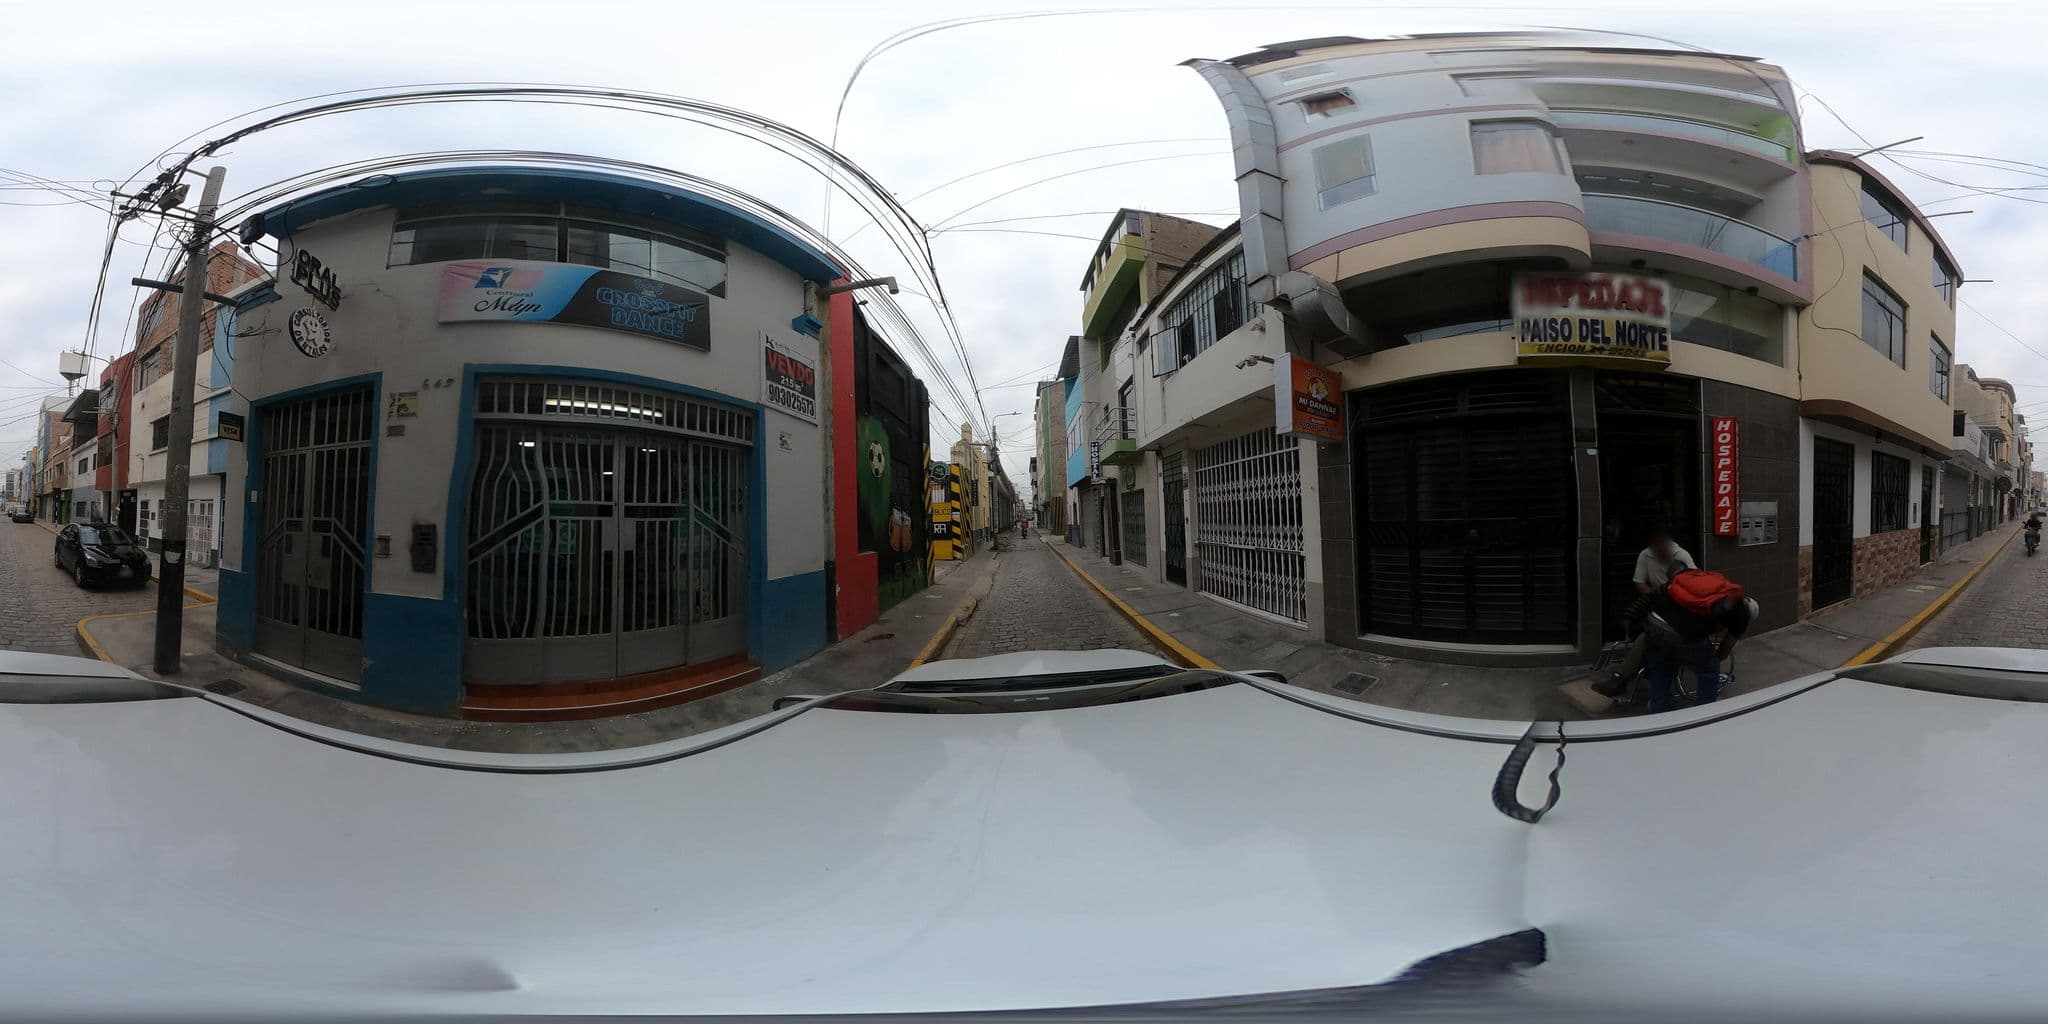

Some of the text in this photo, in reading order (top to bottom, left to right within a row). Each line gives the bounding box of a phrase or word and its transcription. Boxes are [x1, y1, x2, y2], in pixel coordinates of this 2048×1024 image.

[297, 249, 340, 293] ORAL
[596, 287, 697, 322] CROSSFIT
[293, 308, 331, 343] CONSULTORIOS
[611, 307, 685, 339] DANCE
[1520, 317, 1668, 352] PAISO DEL NORTE
[294, 330, 328, 357] DENTALES
[767, 348, 814, 385] VENDO
[768, 384, 815, 417] 903025573
[1298, 397, 1308, 407] MI
[1091, 445, 1099, 480] HOSTAL
[1717, 420, 1733, 533] HOSPEDAJE
